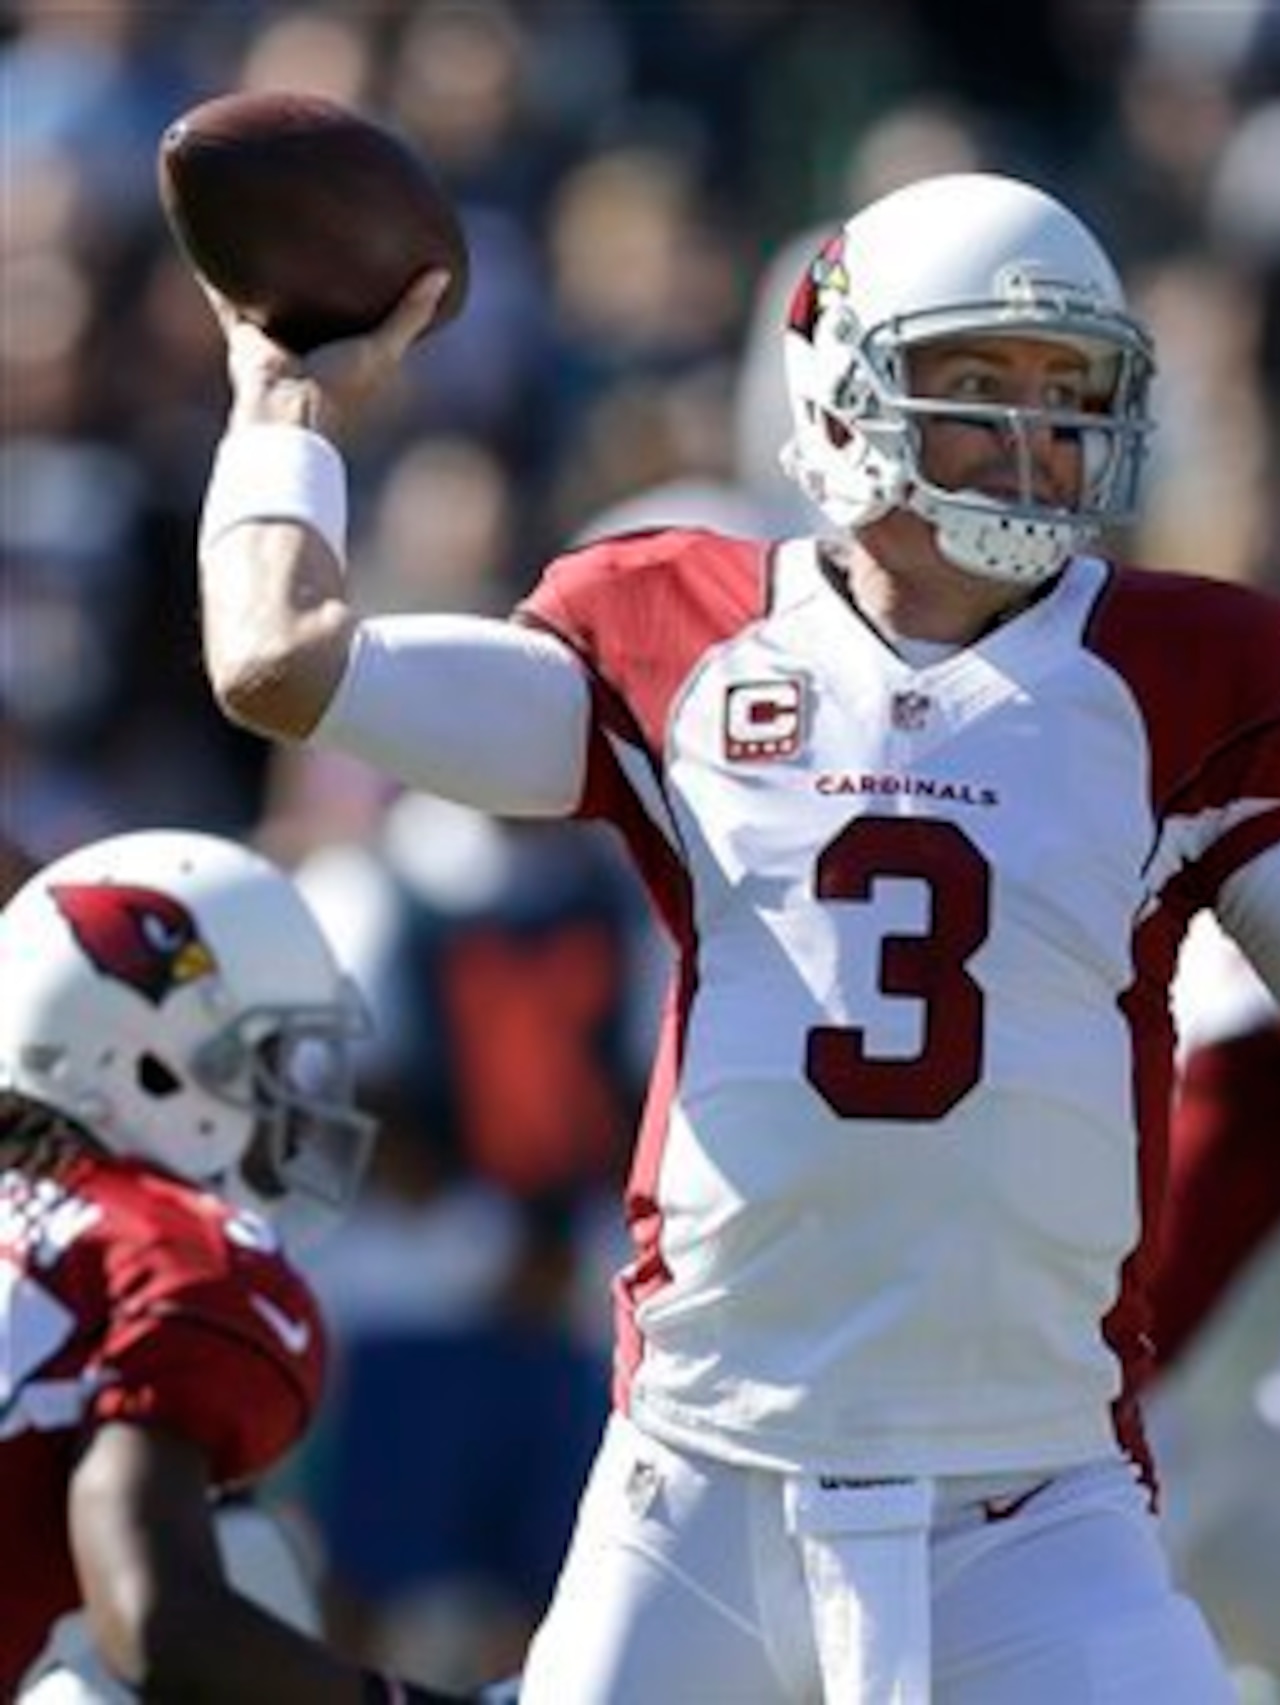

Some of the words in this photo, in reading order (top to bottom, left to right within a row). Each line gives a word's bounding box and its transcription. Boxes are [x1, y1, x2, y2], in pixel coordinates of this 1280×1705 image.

[728, 685, 797, 735] C
[815, 774, 999, 804] CARDINALS
[806, 816, 990, 1121] 3
